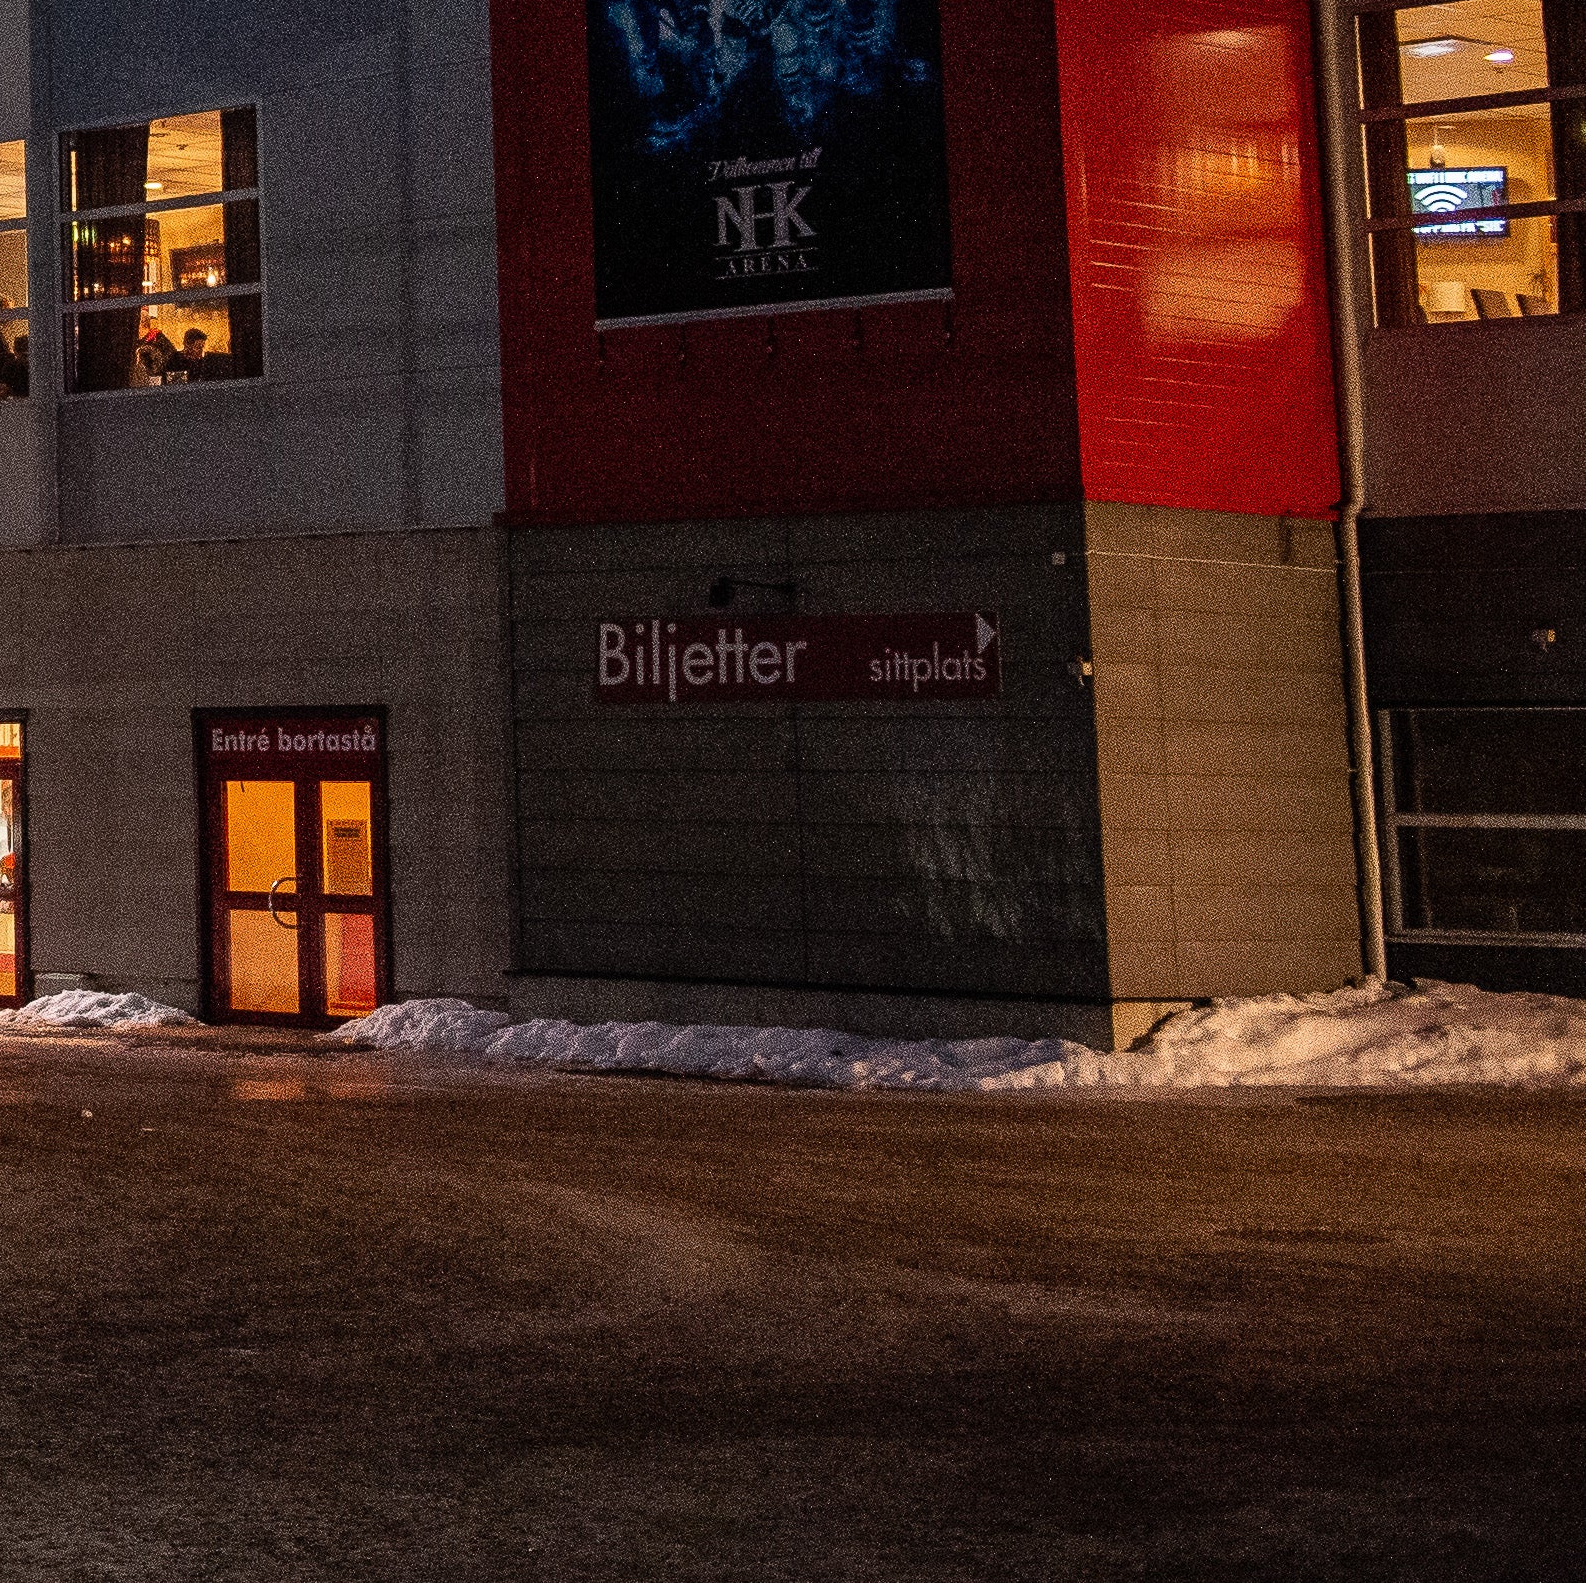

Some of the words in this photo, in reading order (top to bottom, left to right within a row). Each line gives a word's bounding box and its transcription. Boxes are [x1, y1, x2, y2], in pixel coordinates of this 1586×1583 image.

[713, 181, 817, 251] NHK
[727, 254, 809, 276] ARENA
[598, 620, 808, 701] Biljetter
[869, 640, 987, 692] sittplats
[211, 726, 270, 752] Entré
[276, 724, 377, 752] bortastå
